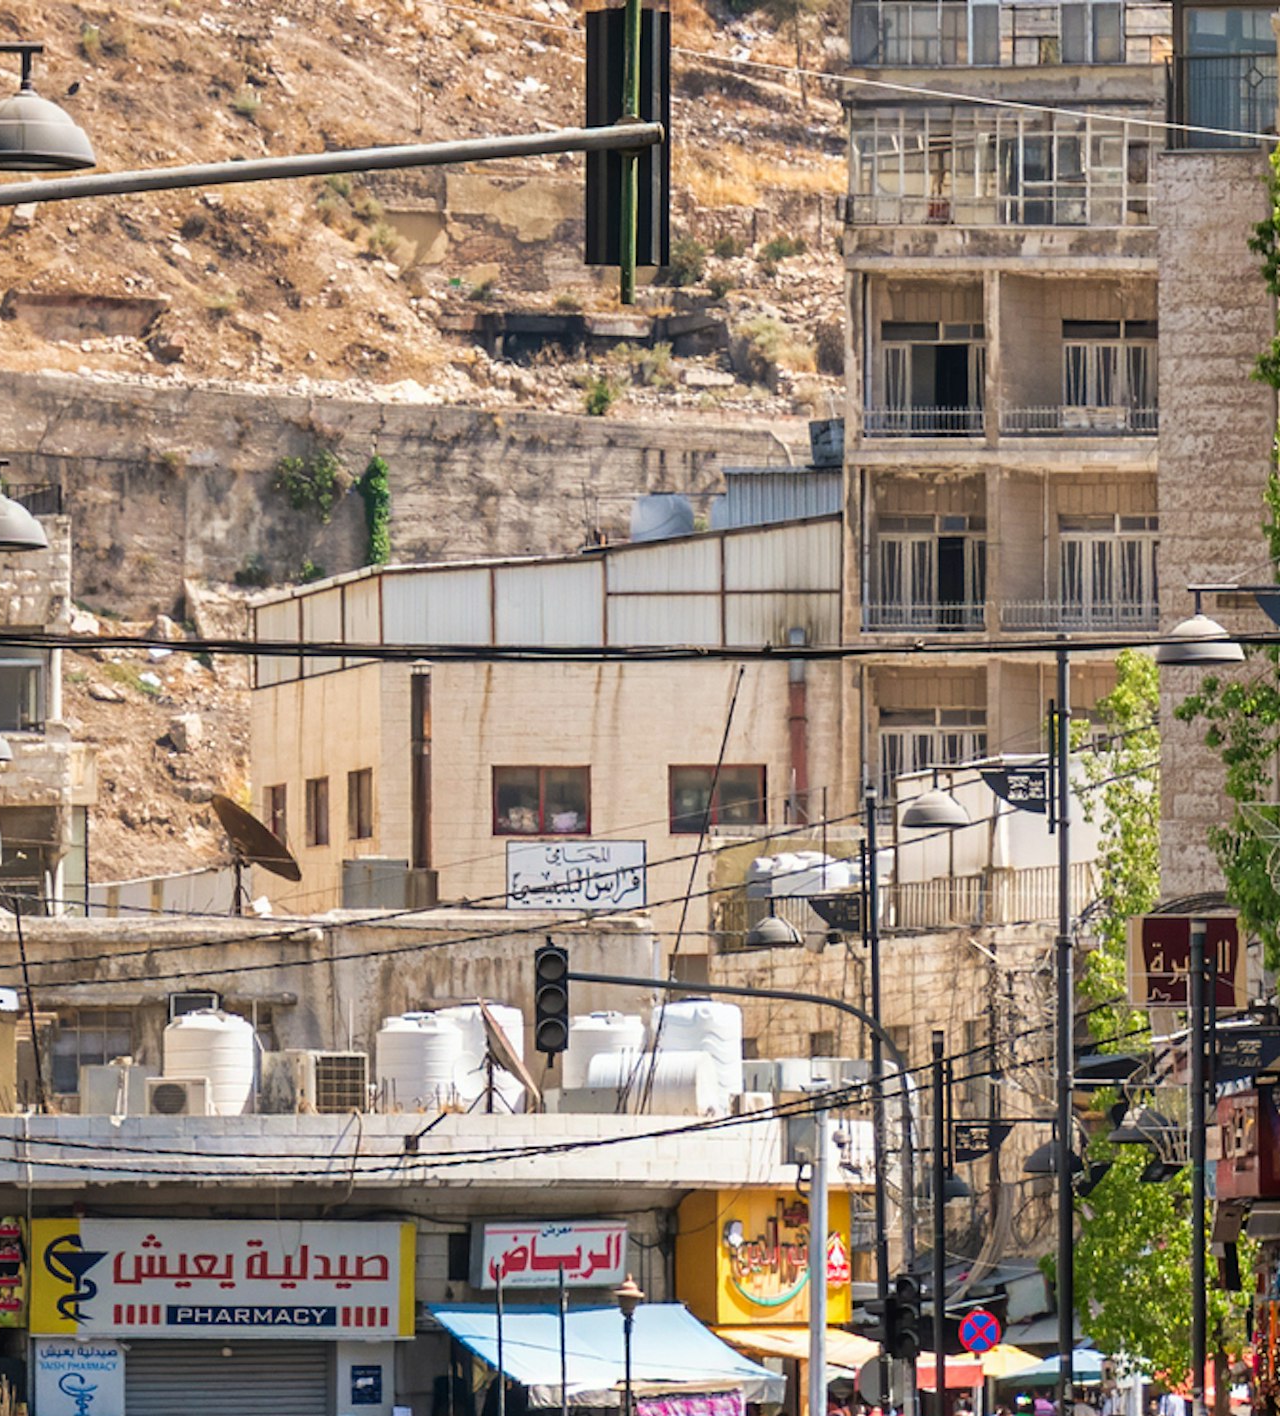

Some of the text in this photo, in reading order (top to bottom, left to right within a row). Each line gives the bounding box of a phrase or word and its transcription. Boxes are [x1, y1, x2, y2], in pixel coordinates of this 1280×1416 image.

[113, 1233, 389, 1289] صيدلية يعيش
[488, 1233, 622, 1282] الرياض
[176, 1307, 328, 1325] PHARMACY
